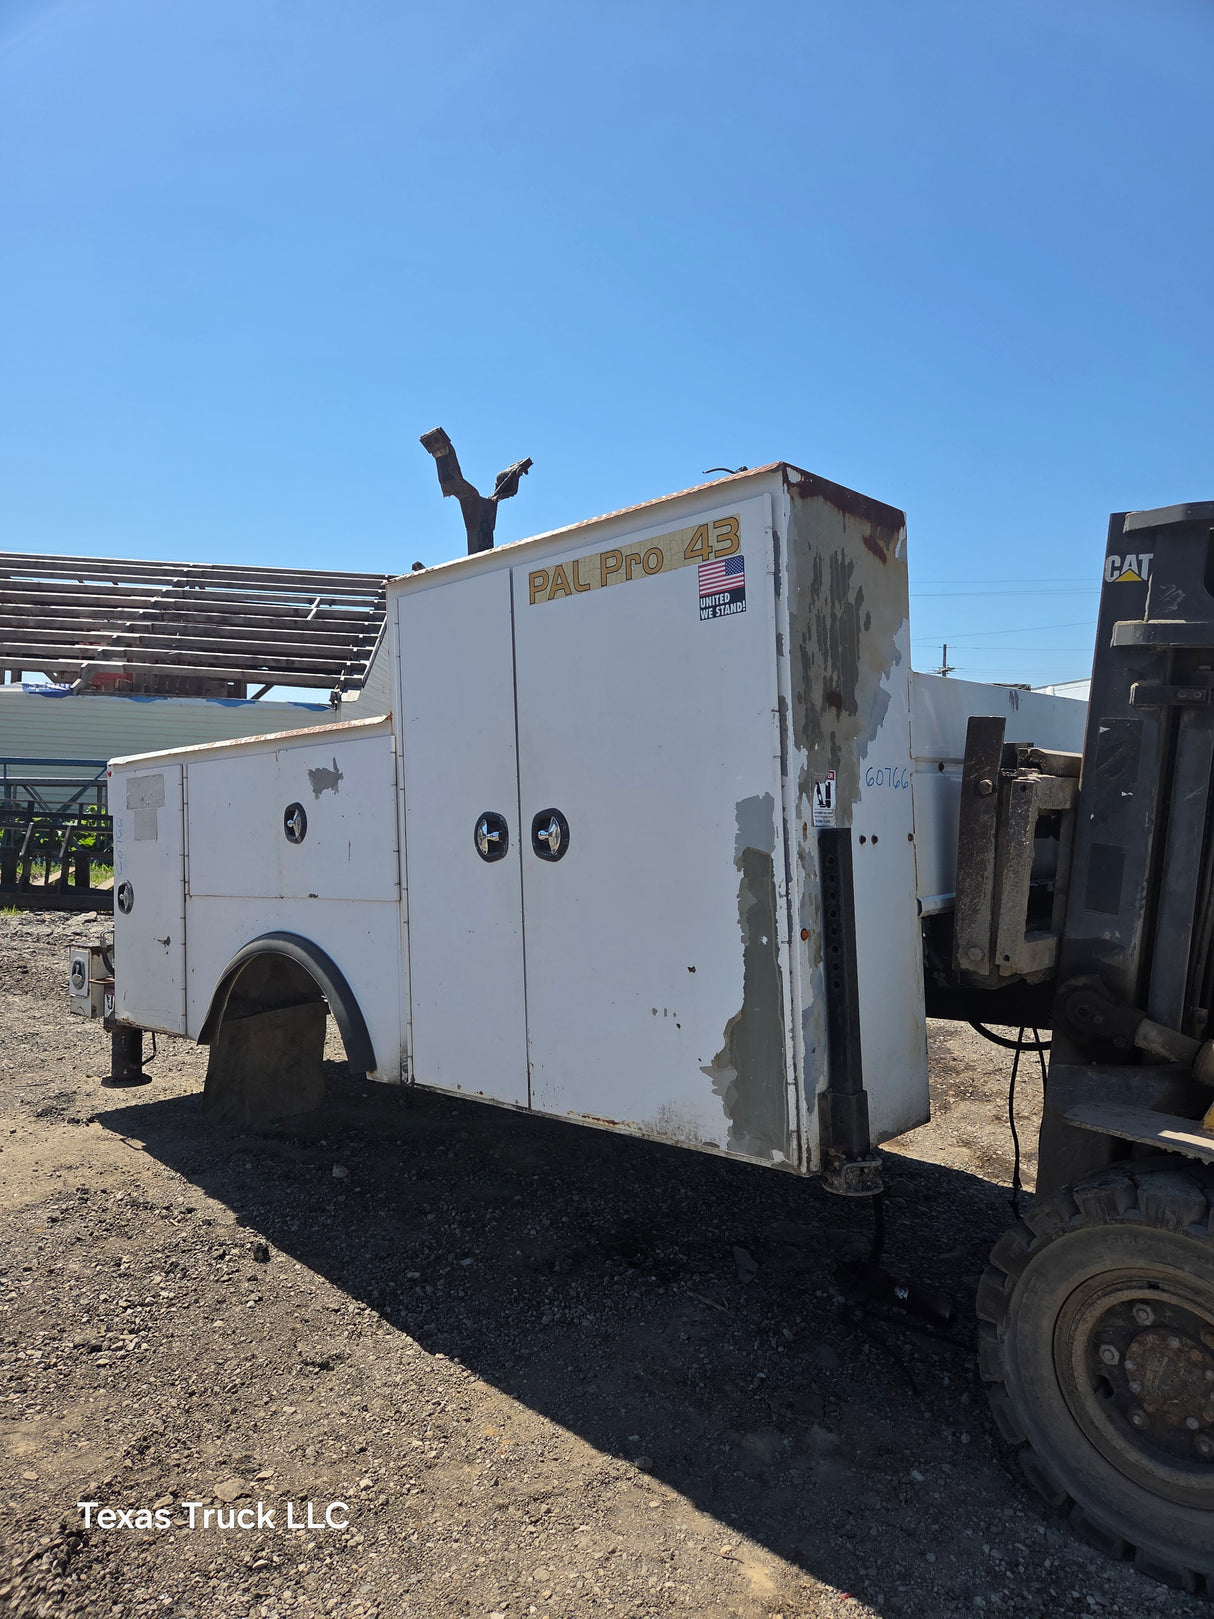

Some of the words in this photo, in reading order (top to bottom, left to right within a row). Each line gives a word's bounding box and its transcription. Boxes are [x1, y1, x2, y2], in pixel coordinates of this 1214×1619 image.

[529, 560, 590, 605] PAL
[601, 547, 664, 587] Pro
[683, 516, 741, 562] 43
[1104, 553, 1154, 583] CAT
[700, 592, 731, 609] UNITED
[700, 607, 714, 620] WE
[715, 600, 746, 617] STAND!
[866, 767, 909, 789] 60766
